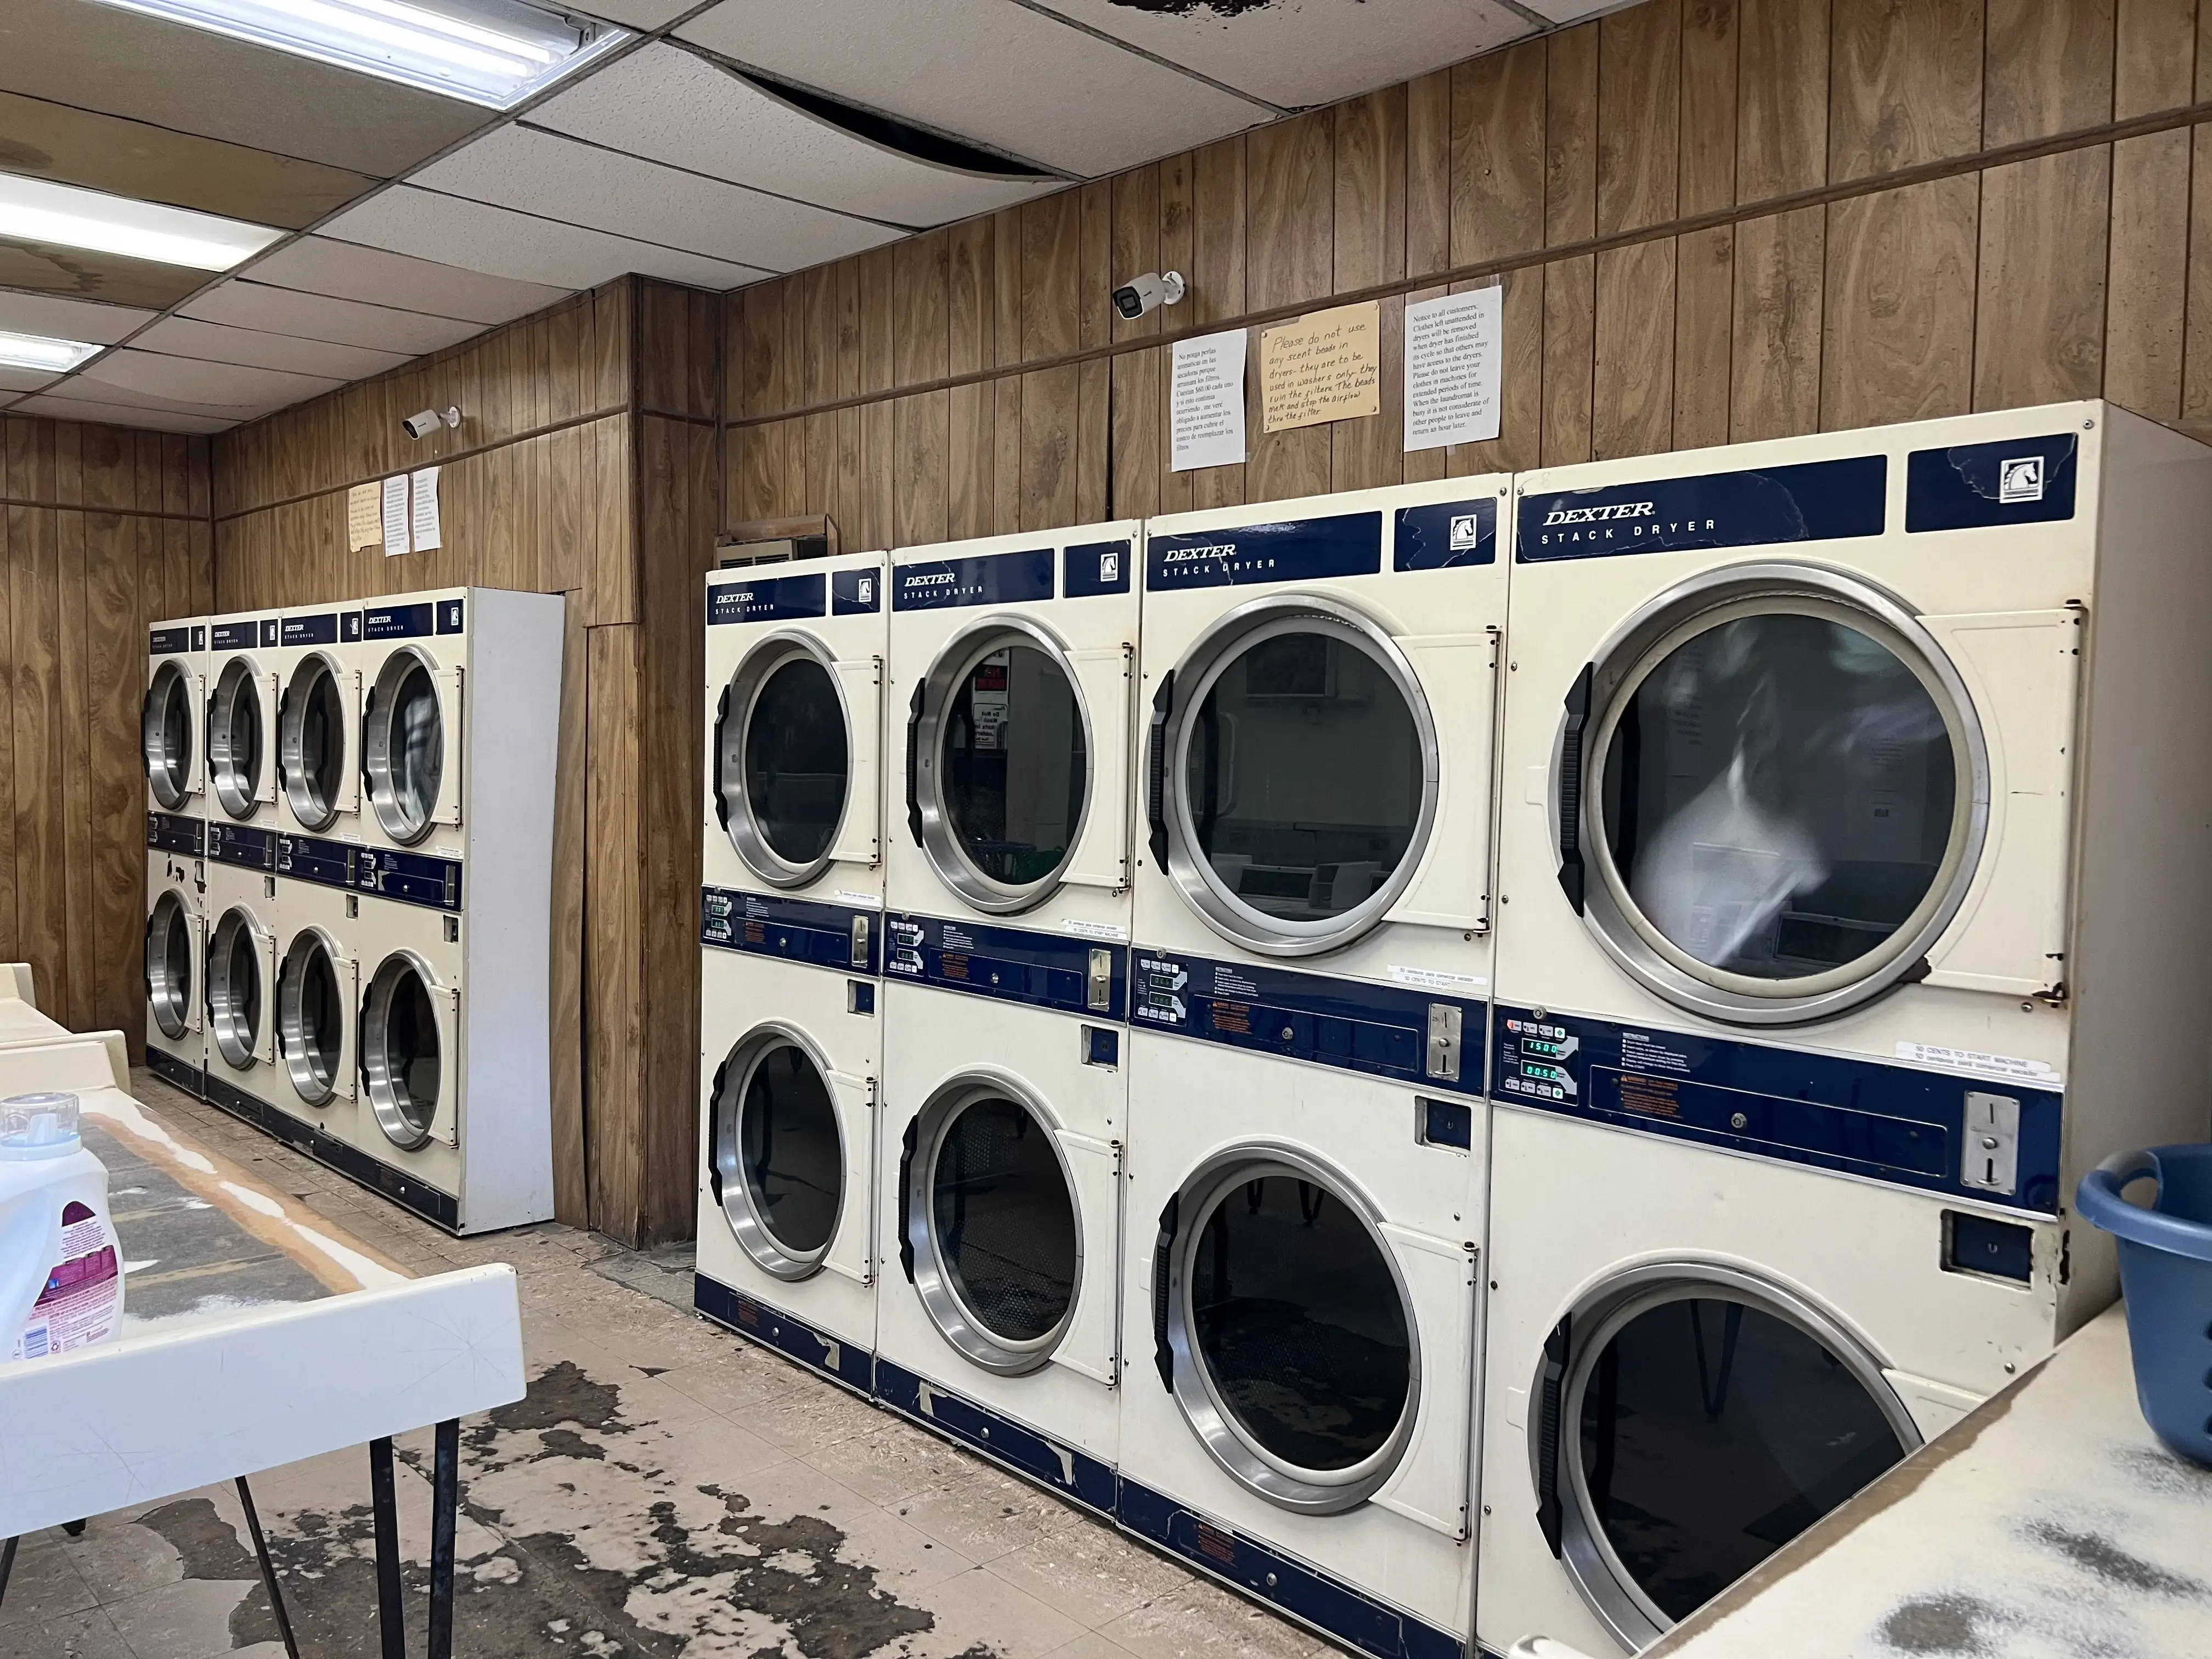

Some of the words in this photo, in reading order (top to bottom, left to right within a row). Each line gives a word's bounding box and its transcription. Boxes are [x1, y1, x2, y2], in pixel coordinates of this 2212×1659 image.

[1413, 324, 1433, 332] Clothes
[1445, 313, 1476, 324] unattended
[1451, 323, 1476, 333] removed
[1272, 336, 1304, 353] Please
[1308, 332, 1319, 345] do
[1324, 325, 1341, 340] not
[1348, 324, 1366, 333] use
[1455, 331, 1479, 342] finished
[1269, 358, 1284, 369] any
[1287, 348, 1312, 360] scent
[1316, 344, 1336, 354] beads
[1421, 351, 1435, 360] cycle
[1300, 363, 1319, 382] they
[1321, 360, 1335, 368] are
[1339, 356, 1348, 364] to
[1352, 352, 1363, 360] be
[1466, 362, 1480, 370] your
[1270, 381, 1285, 391] used
[1297, 374, 1331, 386] washers
[1361, 363, 1377, 376] they
[1440, 374, 1466, 383] machines
[1270, 394, 1286, 403] ruin
[1289, 390, 1301, 398] the
[1335, 379, 1352, 390] The
[1355, 375, 1375, 387] beads
[1413, 387, 1437, 398] extended
[1438, 384, 1459, 395] periods
[1441, 392, 1472, 402] laundromat
[1269, 404, 1285, 413] melt
[1287, 400, 1299, 410] and
[1301, 399, 1317, 409] stop
[1319, 395, 1329, 404] the
[1449, 401, 1481, 410] considerate
[1268, 415, 1283, 424] thru
[1428, 415, 1446, 425] people
[1543, 502, 1653, 526] DEXTER
[1542, 529, 1613, 544] STACK
[1634, 520, 1714, 536] DRYER
[1164, 544, 1235, 562] DEXTER
[1163, 566, 1210, 577] STACK
[1223, 559, 1274, 571] DRYER
[905, 573, 955, 586] DEXTER
[716, 592, 754, 603] DEXTER
[904, 590, 938, 599] STACK
[946, 586, 983, 596] DRYER
[368, 616, 391, 624] DEXTER
[1530, 1042, 1557, 1053] 1500
[1927, 1047, 1950, 1056] CENTS
[1967, 1053, 1990, 1062] START
[1994, 1056, 2028, 1068] MACHINE
